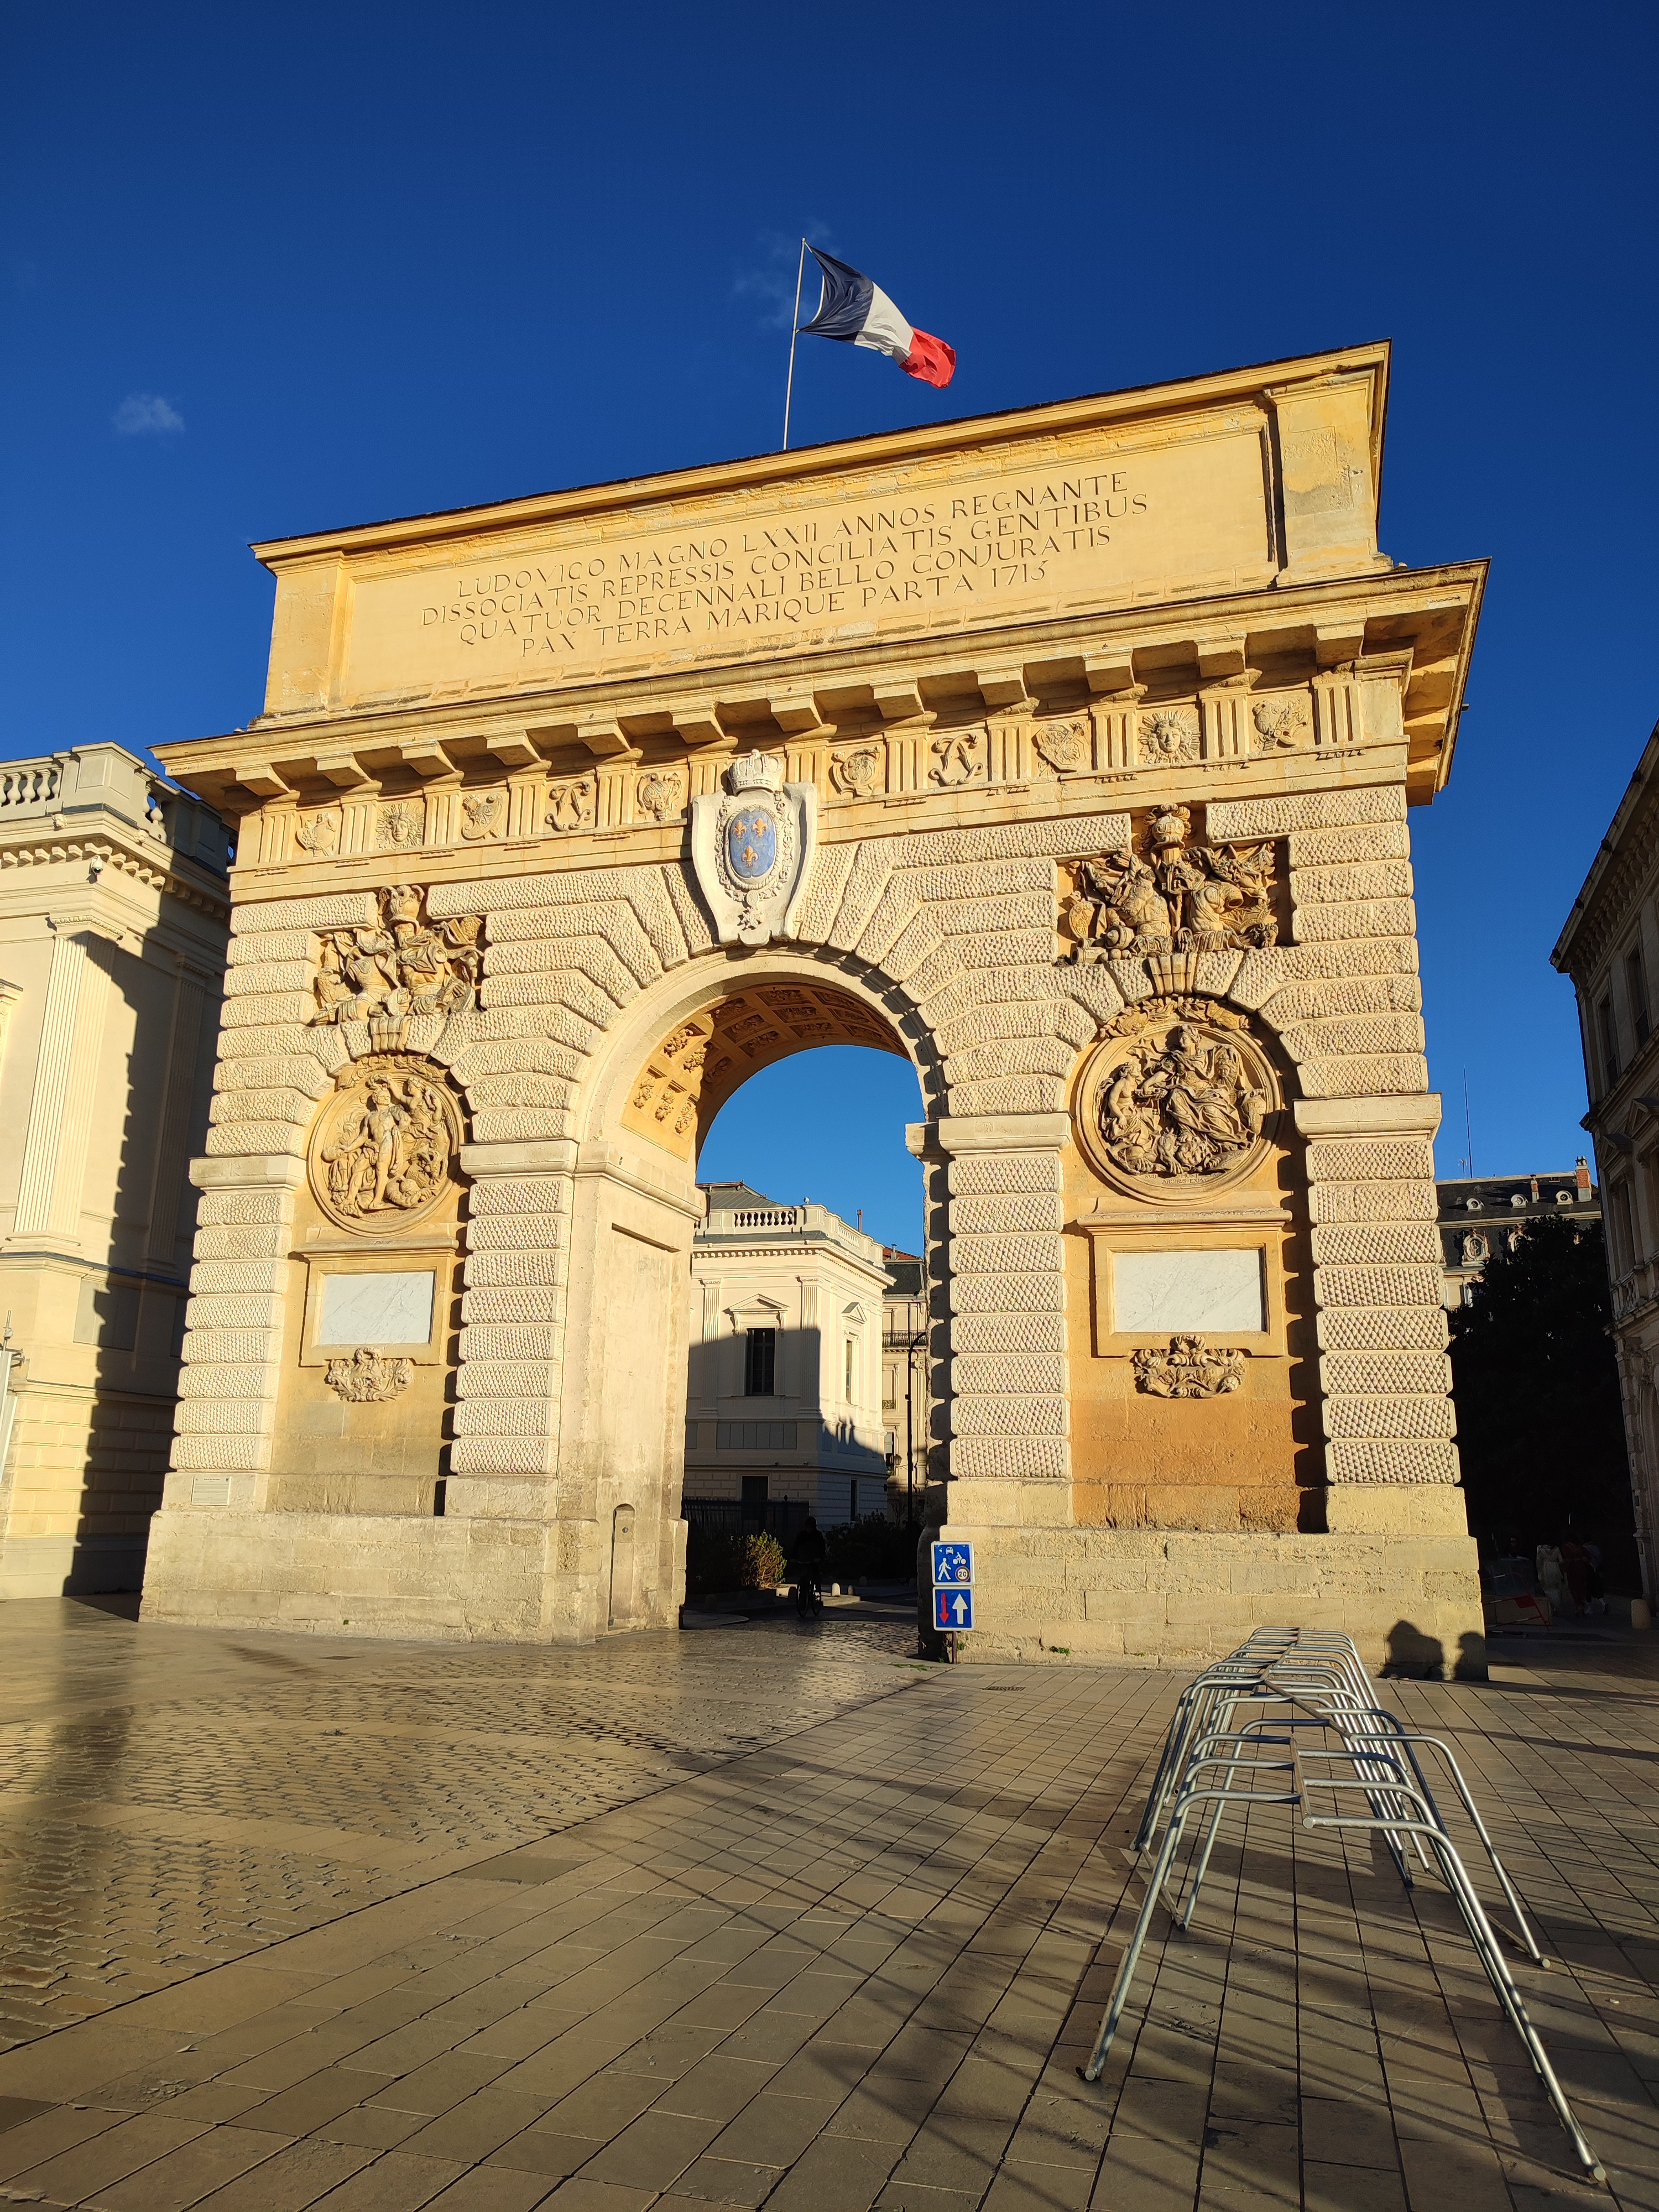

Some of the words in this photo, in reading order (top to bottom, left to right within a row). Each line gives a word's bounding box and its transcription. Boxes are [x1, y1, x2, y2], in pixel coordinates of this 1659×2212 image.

[421, 583, 587, 627] DISSOCIATIS
[602, 560, 734, 598] REPRESSIS
[750, 525, 952, 575] CONCILIATIS
[971, 493, 1147, 540] GENTIBUS
[456, 559, 605, 598] LUDOVICO
[619, 538, 727, 572] MAGNO
[742, 523, 817, 552] LXXII
[833, 504, 935, 538] ANNOS
[951, 471, 1128, 519] REGNANTE
[460, 604, 602, 645] QUATUOR
[617, 576, 784, 619] DECENNALI
[799, 560, 894, 592] BELLO
[912, 525, 1111, 574] CONJURATIS
[521, 631, 576, 658] PAX
[593, 615, 692, 646] TERRA
[707, 591, 844, 631] MARIQUE
[861, 574, 974, 608] PARTA
[991, 559, 1049, 588] 1715
